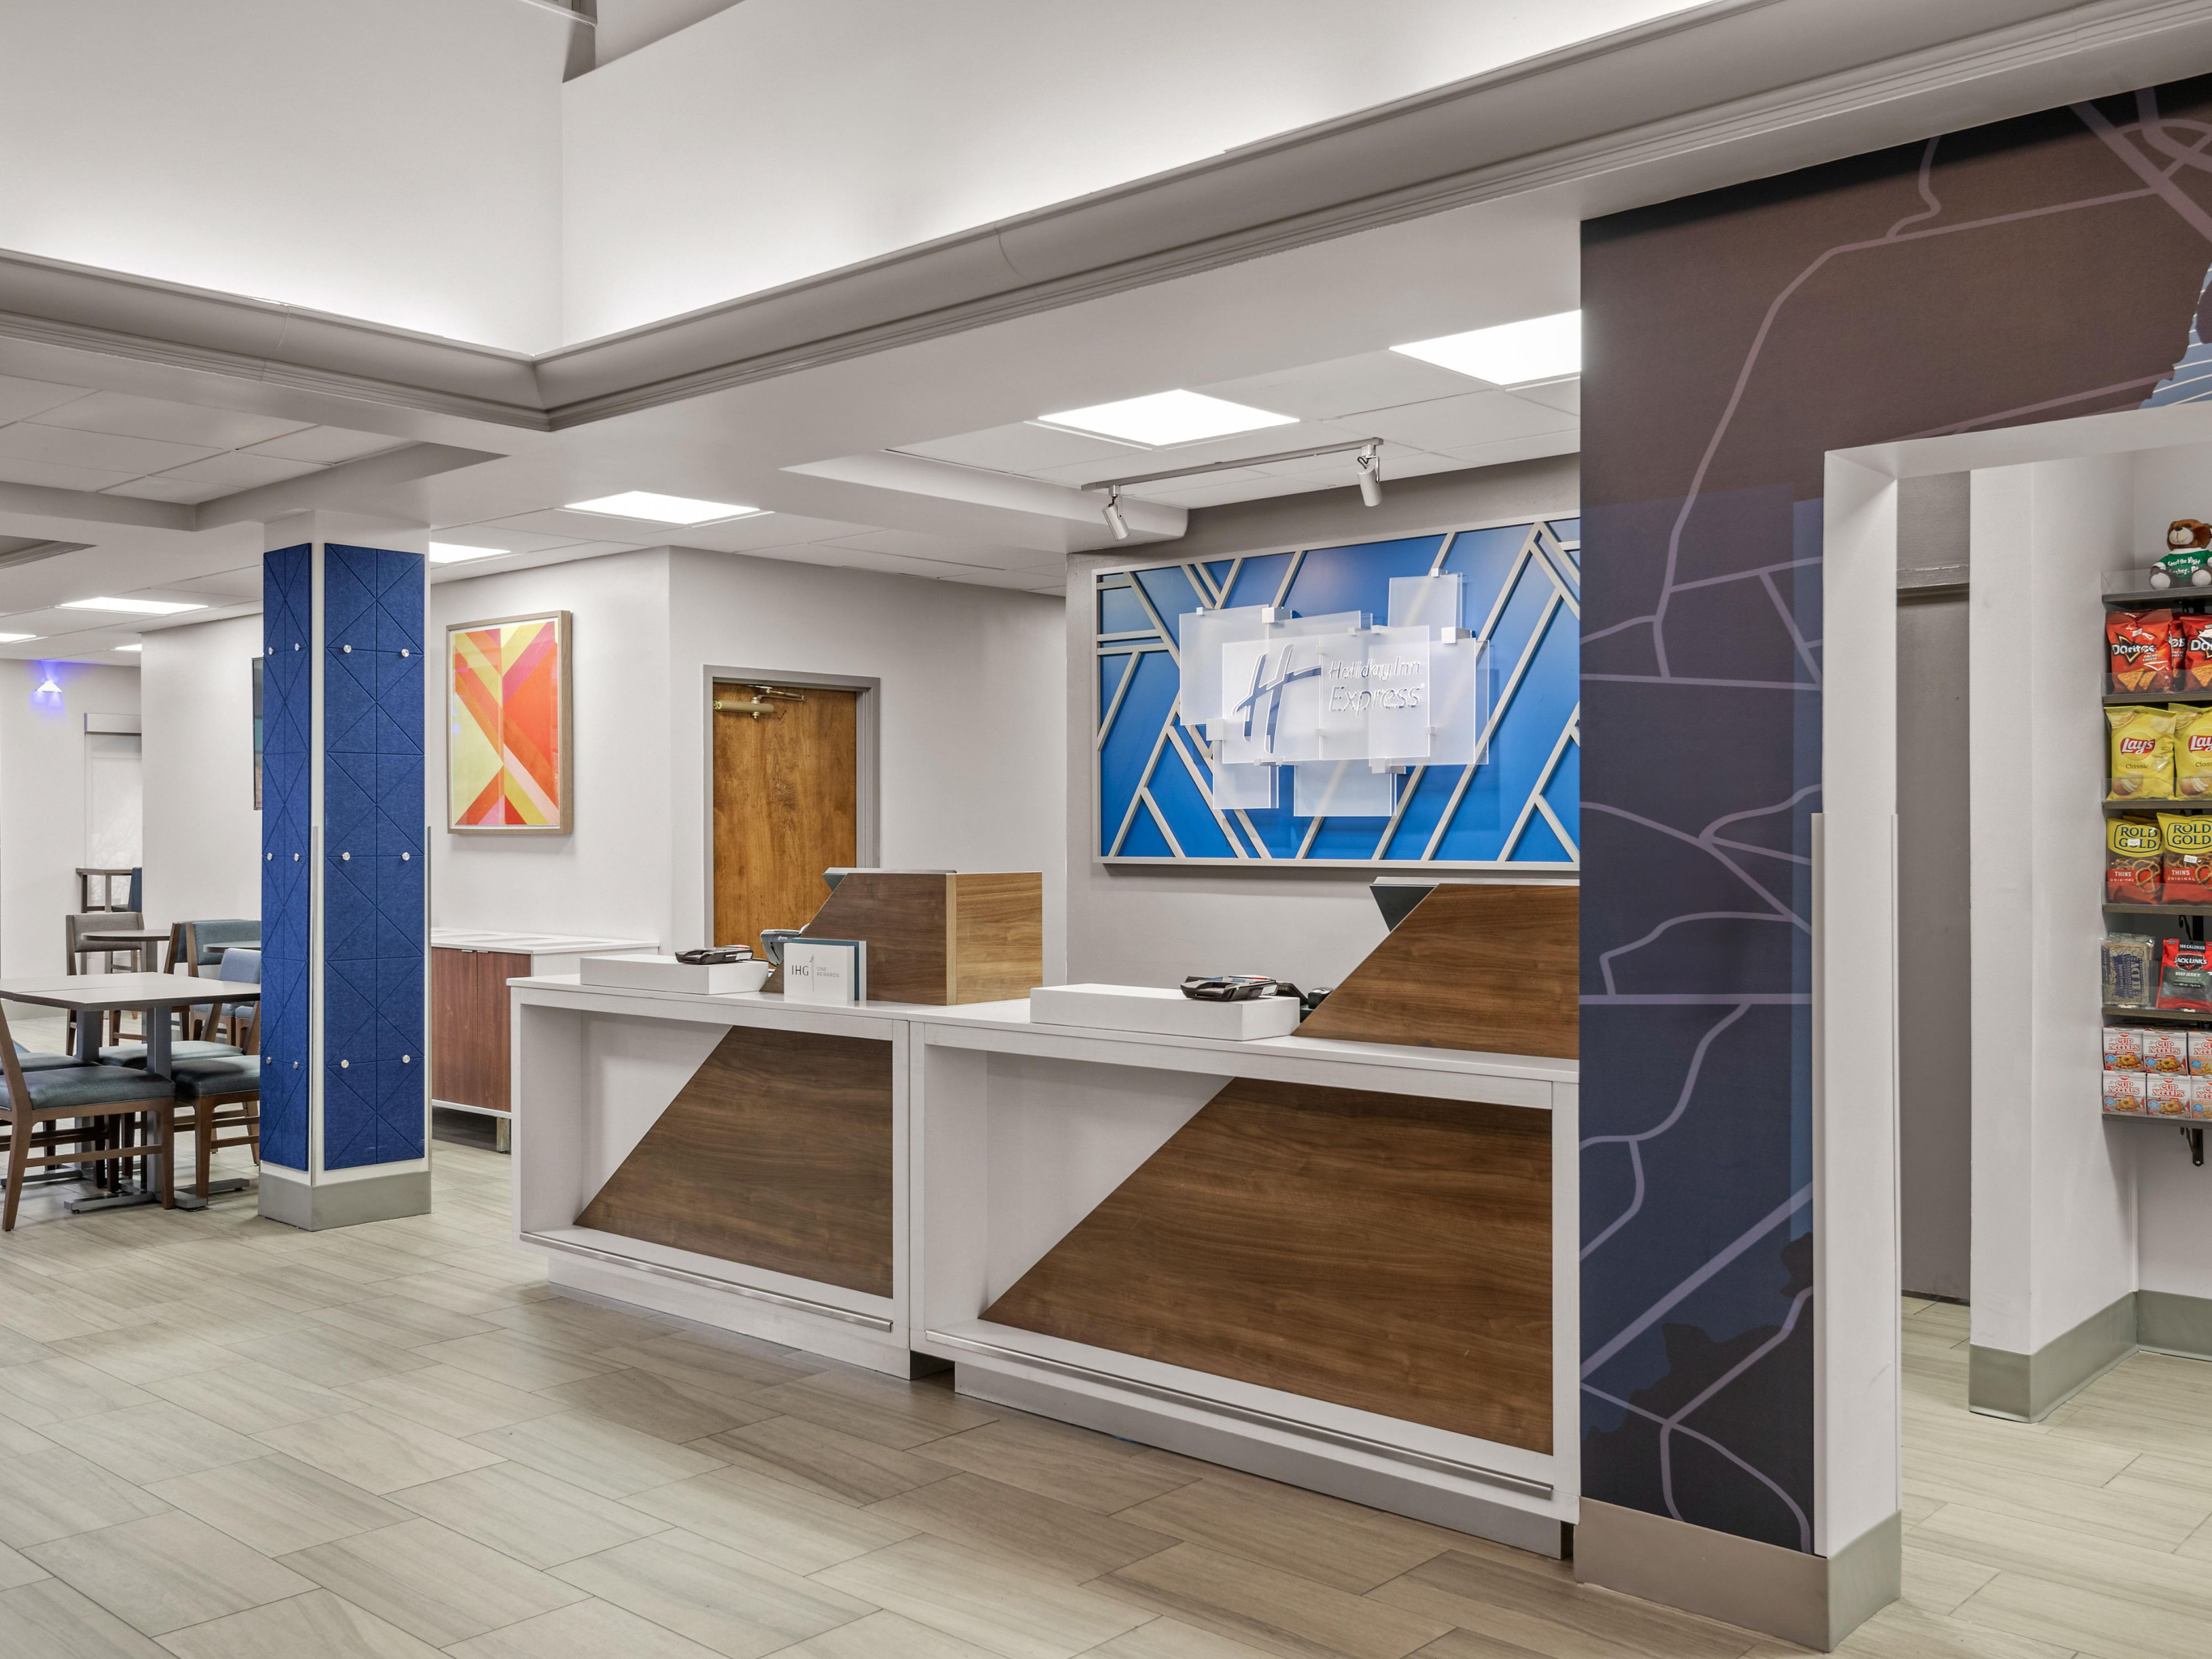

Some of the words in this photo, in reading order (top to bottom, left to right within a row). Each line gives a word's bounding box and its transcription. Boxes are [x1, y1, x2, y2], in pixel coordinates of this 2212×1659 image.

[2188, 556, 2200, 565] Night
[1328, 658, 1392, 681] Holiday
[1394, 656, 1421, 676] Inn
[1329, 686, 1420, 718] Express
[2122, 738, 2154, 754] Lay's
[2120, 827, 2158, 838] ROLD
[2173, 824, 2211, 834] ROLD
[2119, 838, 2157, 849] GLD
[2172, 835, 2211, 845] GOLD
[791, 965, 809, 976] IHG
[2148, 1046, 2180, 1055] NOODLES
